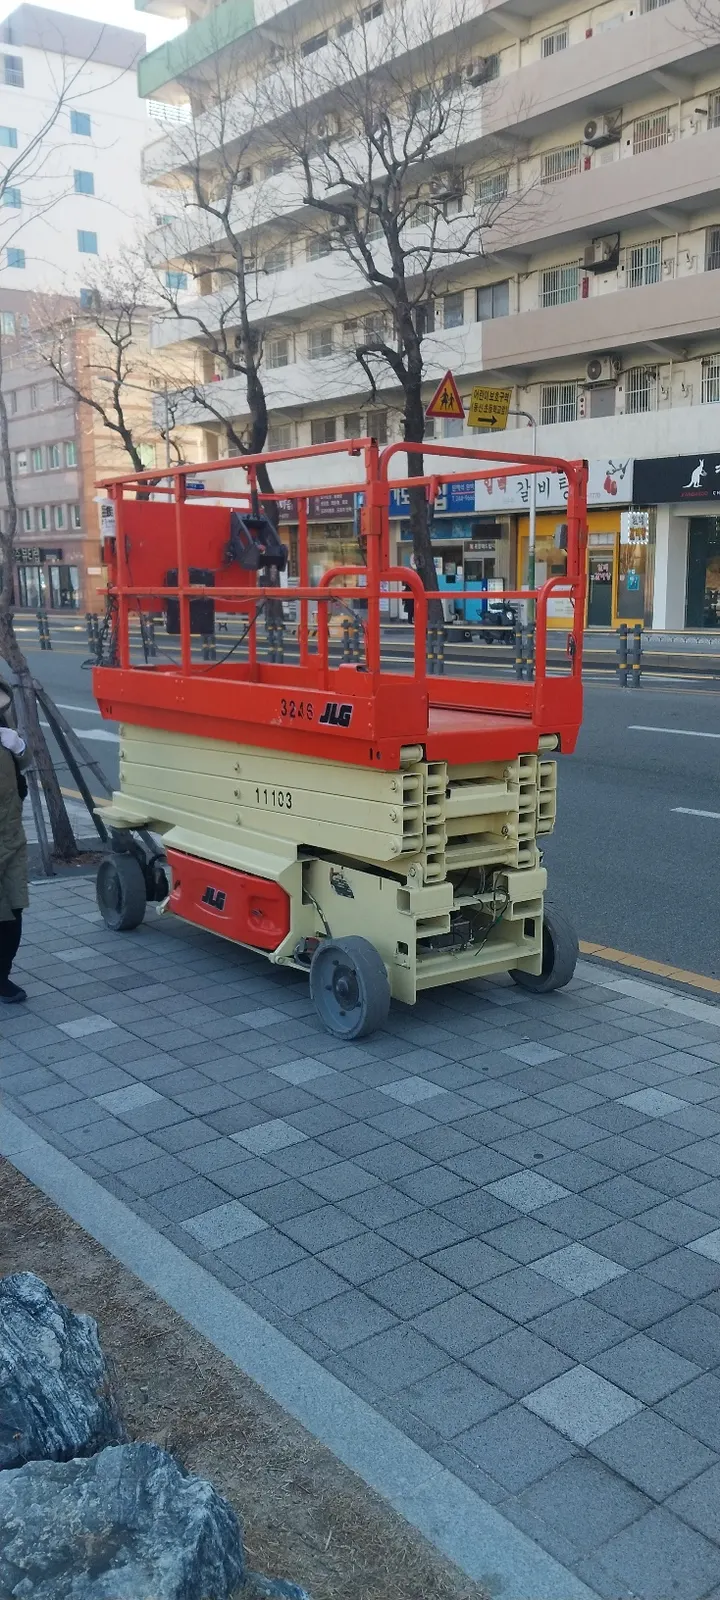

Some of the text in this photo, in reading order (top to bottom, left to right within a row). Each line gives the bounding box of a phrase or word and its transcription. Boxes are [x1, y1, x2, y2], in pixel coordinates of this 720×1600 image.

[318, 702, 354, 728] JLG
[255, 787, 293, 809] 11103
[201, 885, 227, 911] JLG
